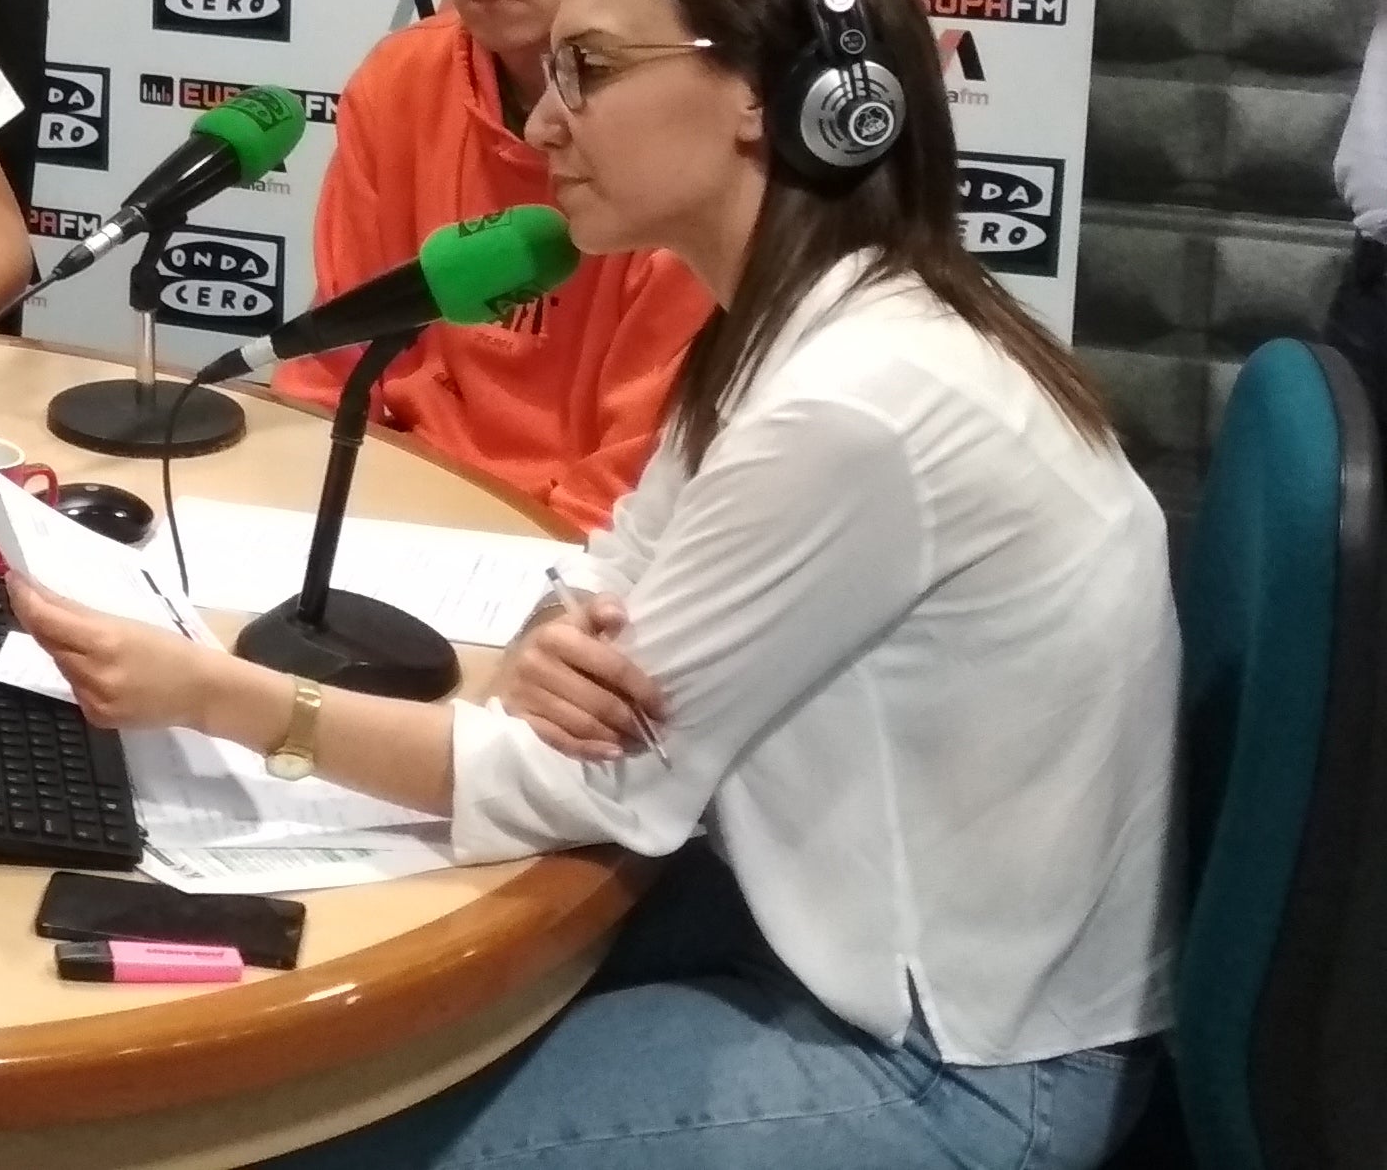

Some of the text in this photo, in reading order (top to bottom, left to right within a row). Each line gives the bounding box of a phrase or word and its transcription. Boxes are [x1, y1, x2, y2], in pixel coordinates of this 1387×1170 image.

[48, 87, 84, 106] DA
[49, 122, 84, 142] RO
[958, 180, 1029, 204] NDA
[171, 249, 258, 274] ONDA
[176, 285, 257, 310] CERO
